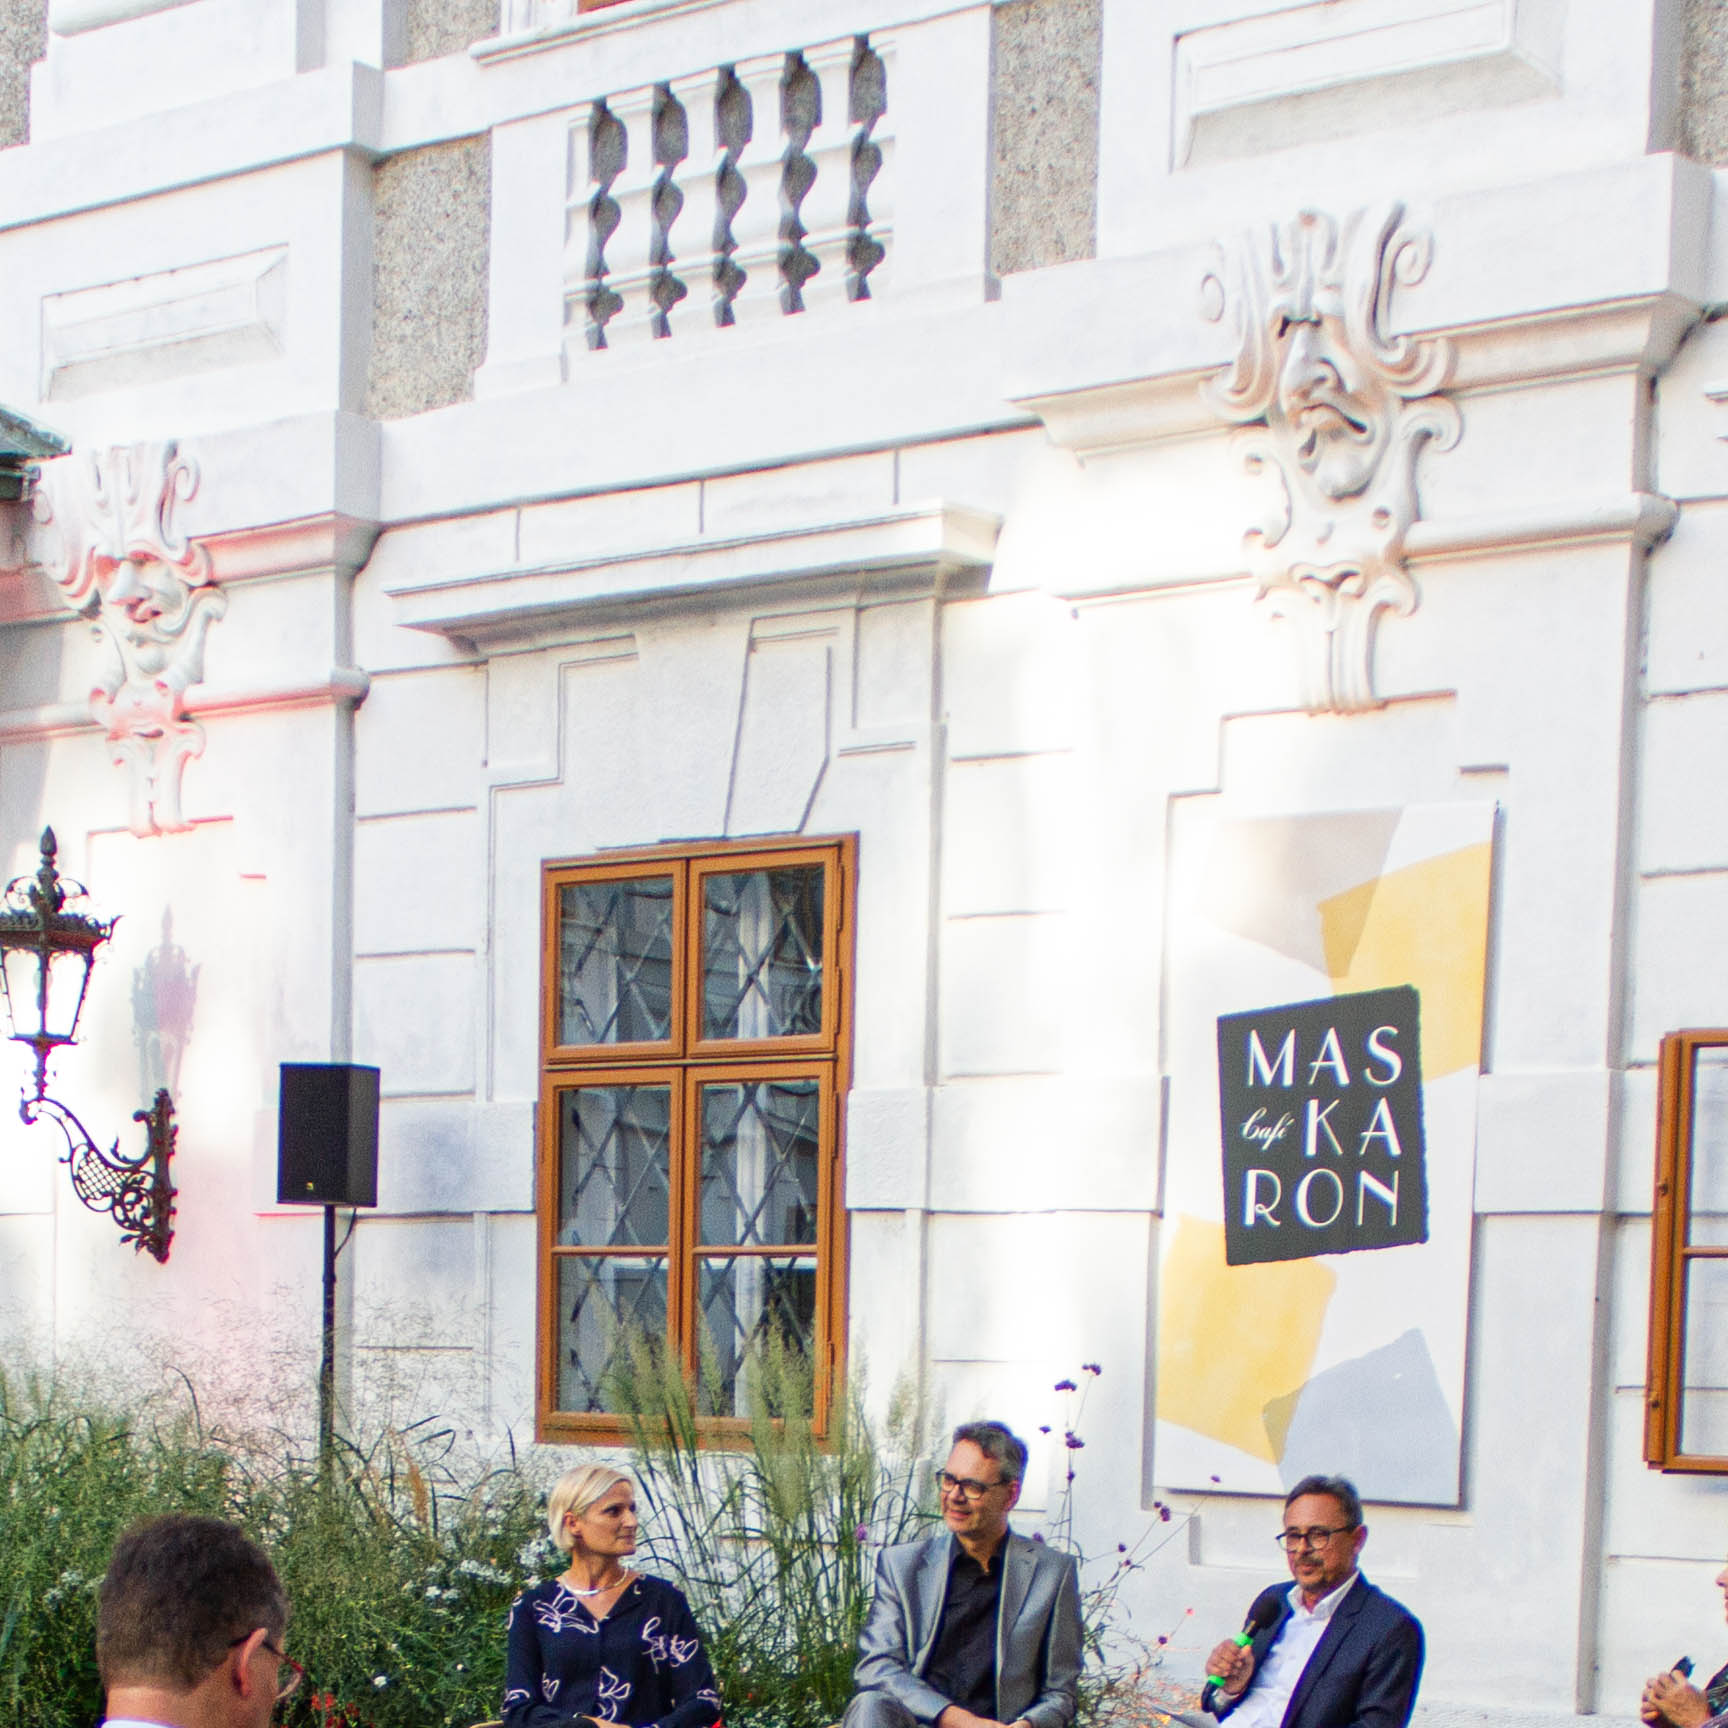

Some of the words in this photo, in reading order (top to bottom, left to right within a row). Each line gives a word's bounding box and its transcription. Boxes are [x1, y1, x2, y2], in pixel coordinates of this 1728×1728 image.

[1247, 1025, 1403, 1088] MAS
[1240, 1107, 1296, 1150] Café
[1304, 1097, 1402, 1157] KA
[1242, 1168, 1401, 1228] RON
